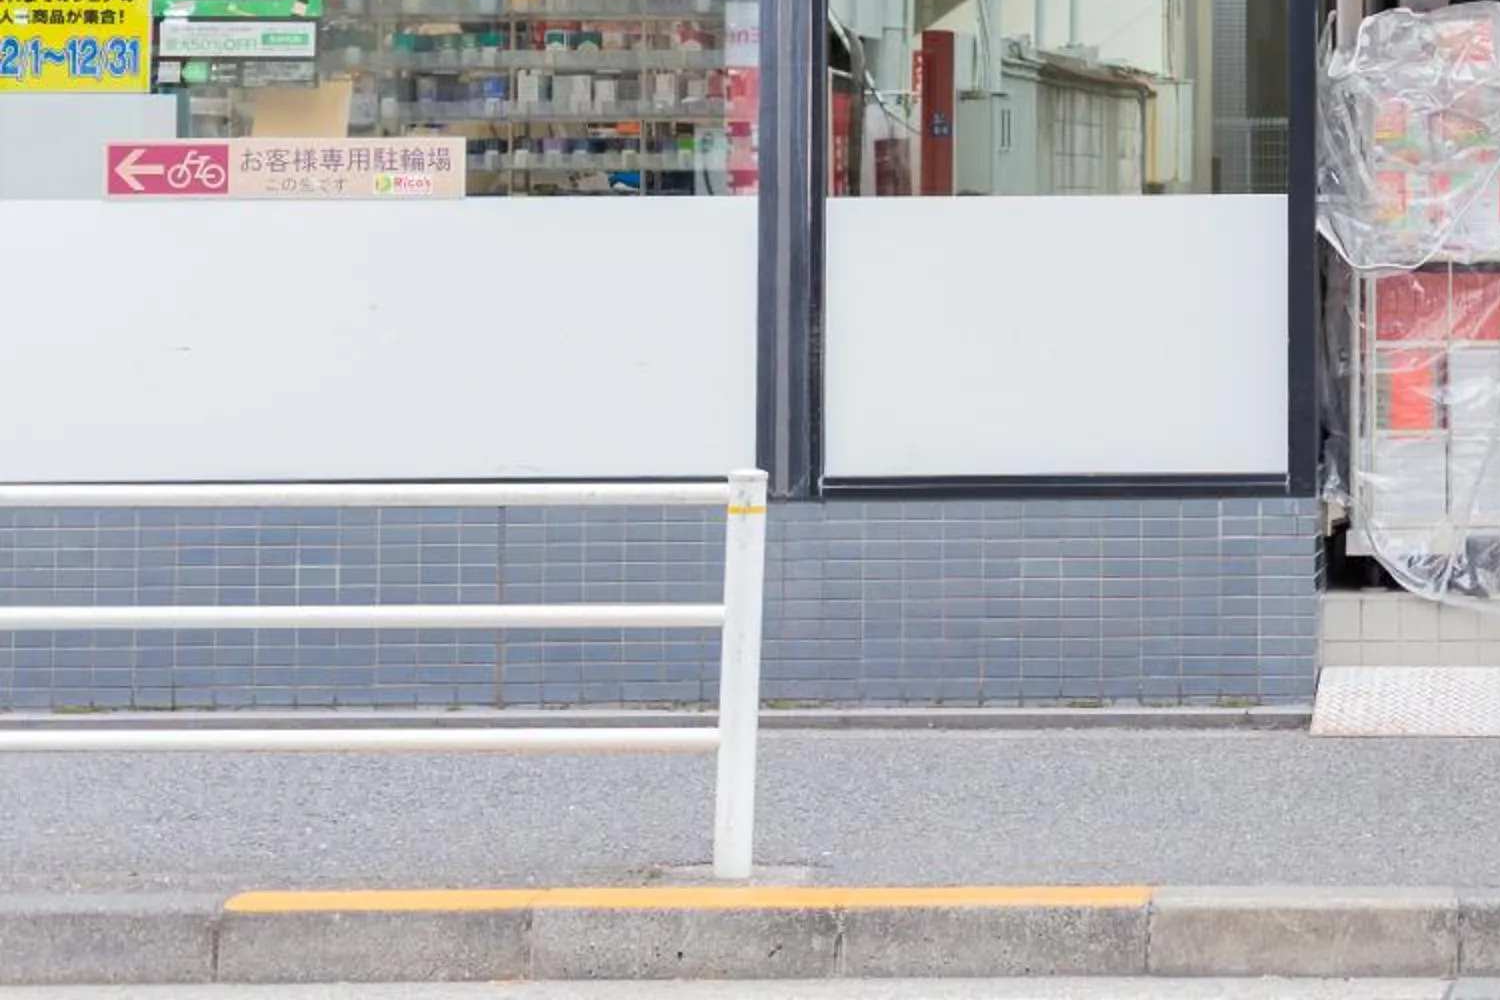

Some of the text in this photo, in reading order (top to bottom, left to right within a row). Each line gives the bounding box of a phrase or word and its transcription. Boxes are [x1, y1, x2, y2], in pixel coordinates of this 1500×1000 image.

[240, 147, 452, 173] お客様専用駐輪場
